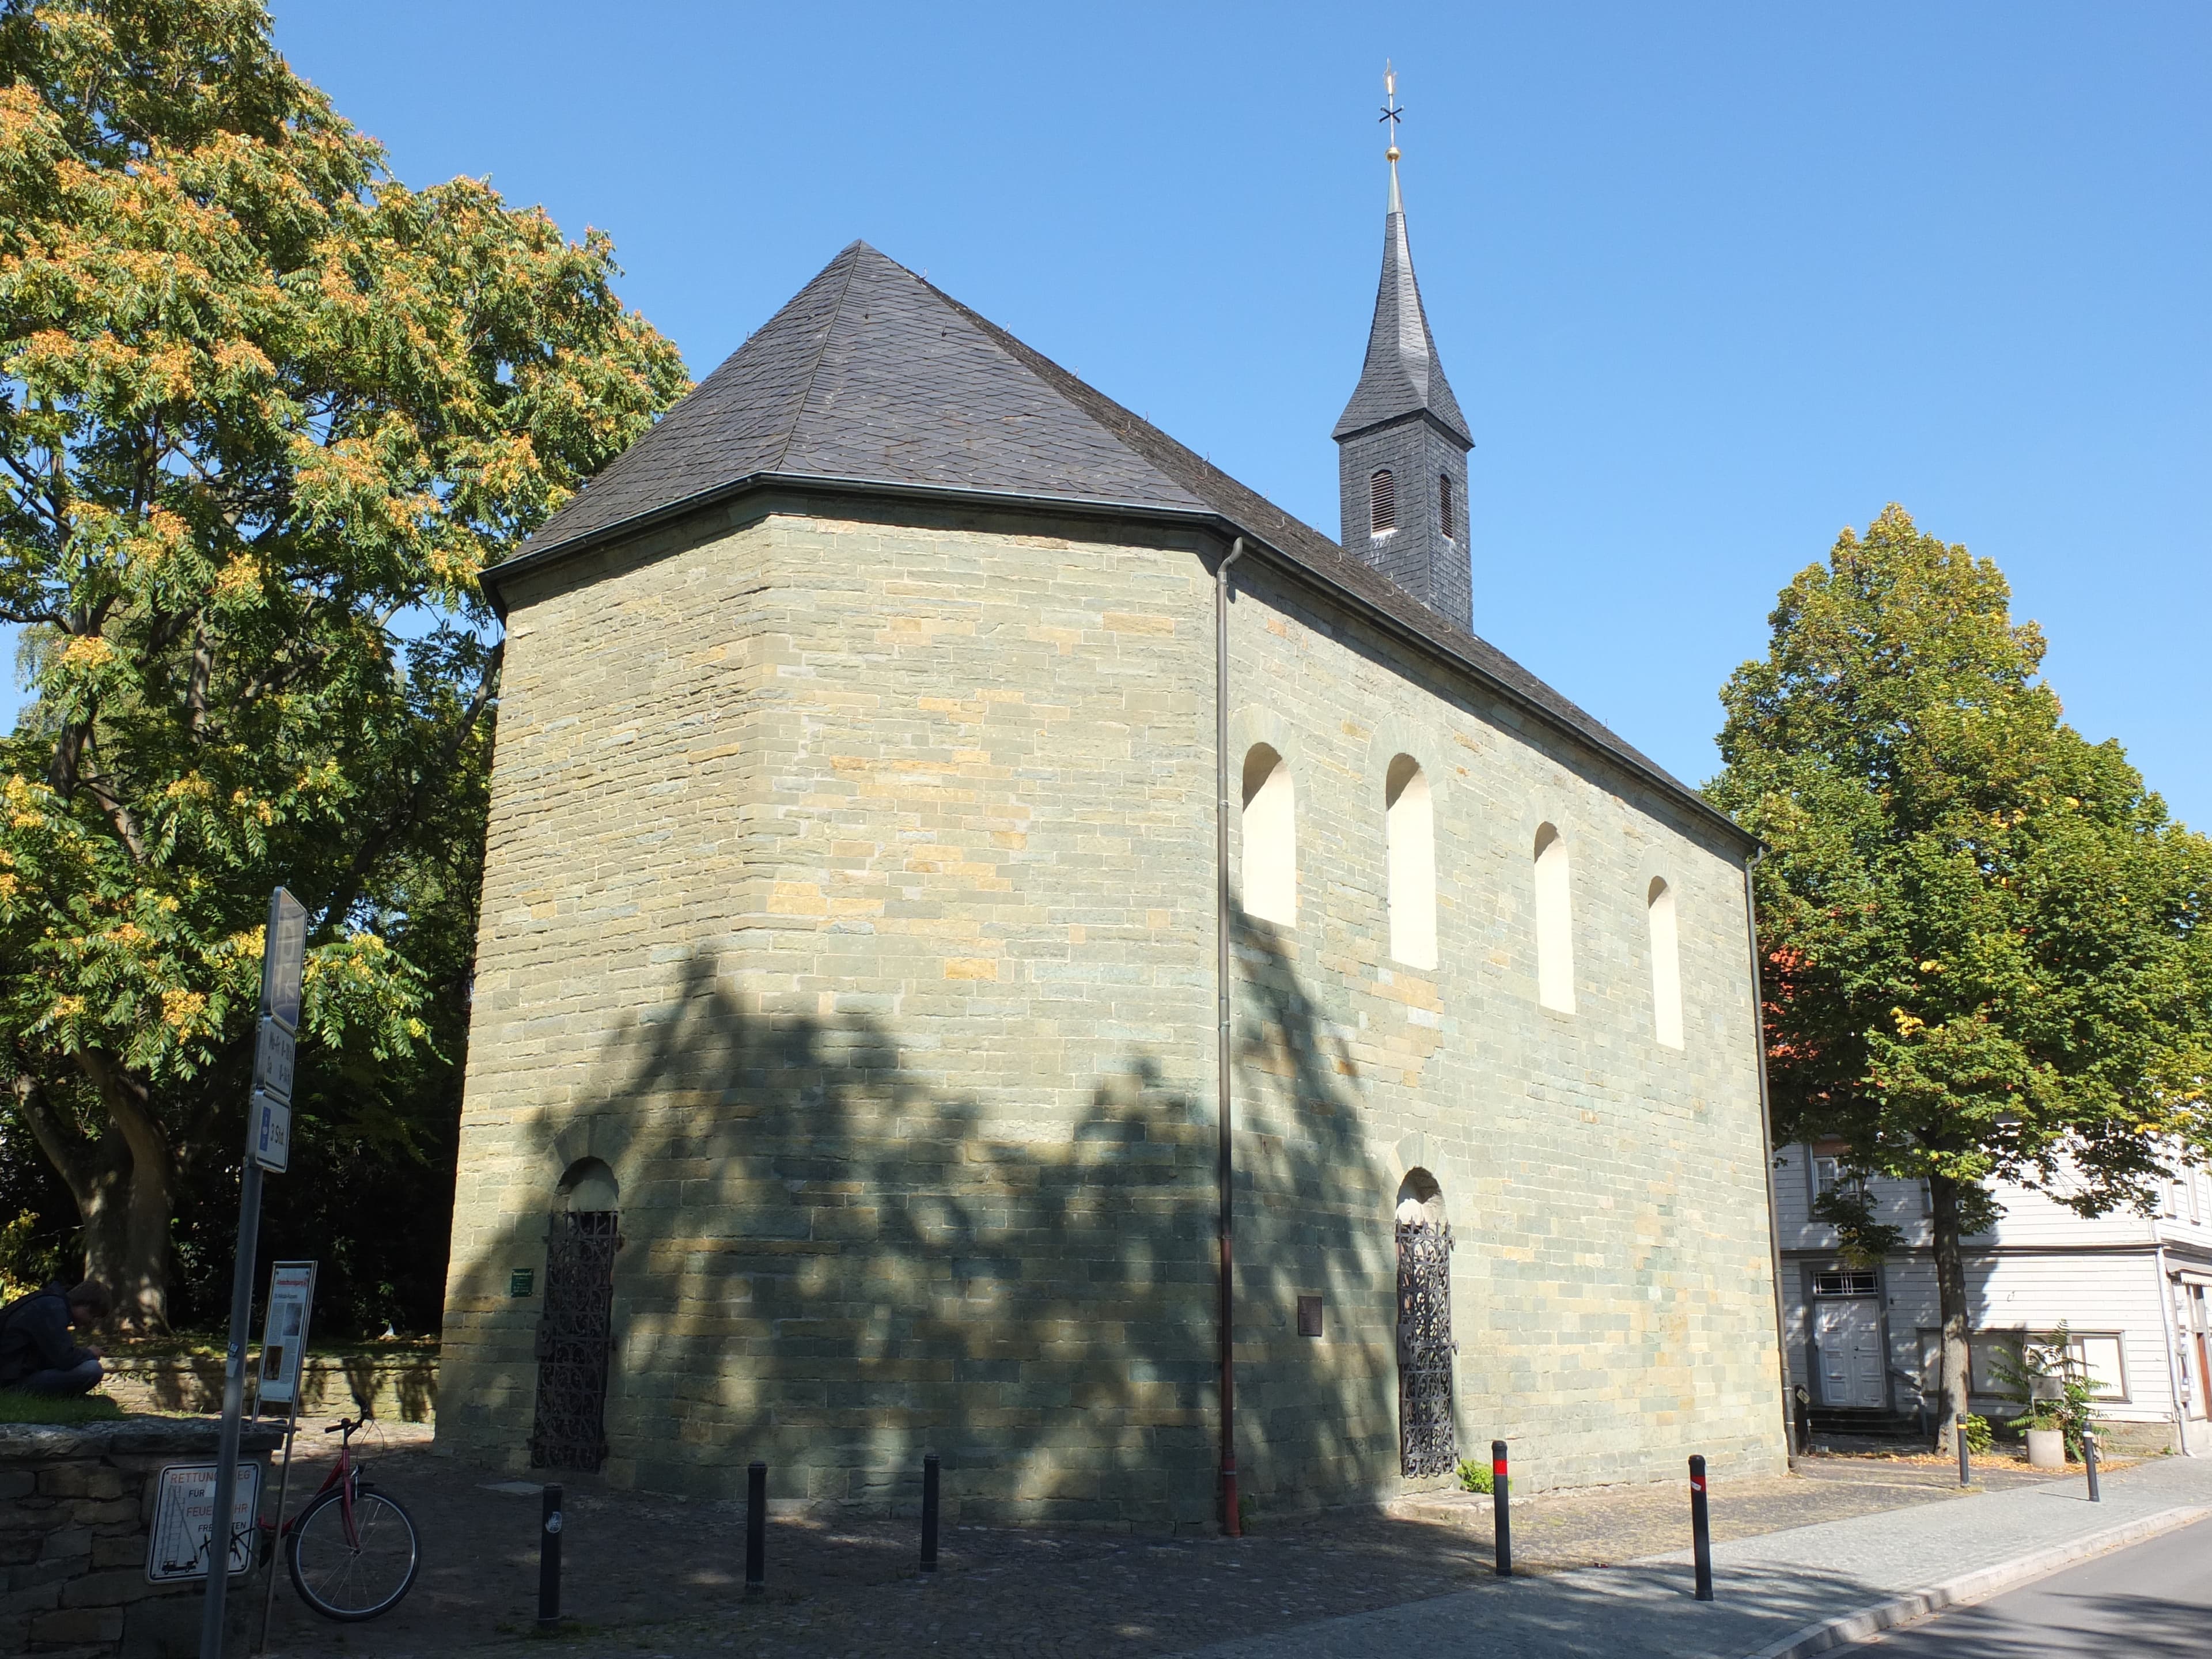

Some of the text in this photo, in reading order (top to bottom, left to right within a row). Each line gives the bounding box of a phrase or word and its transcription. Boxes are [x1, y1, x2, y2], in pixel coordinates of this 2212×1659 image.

[270, 1123, 274, 1141] 3
[171, 1470, 251, 1484] RETTUNEG
[188, 1488, 204, 1498] FÜR
[186, 1503, 248, 1517] FEUEHR
[198, 1521, 247, 1532] FRETEN
